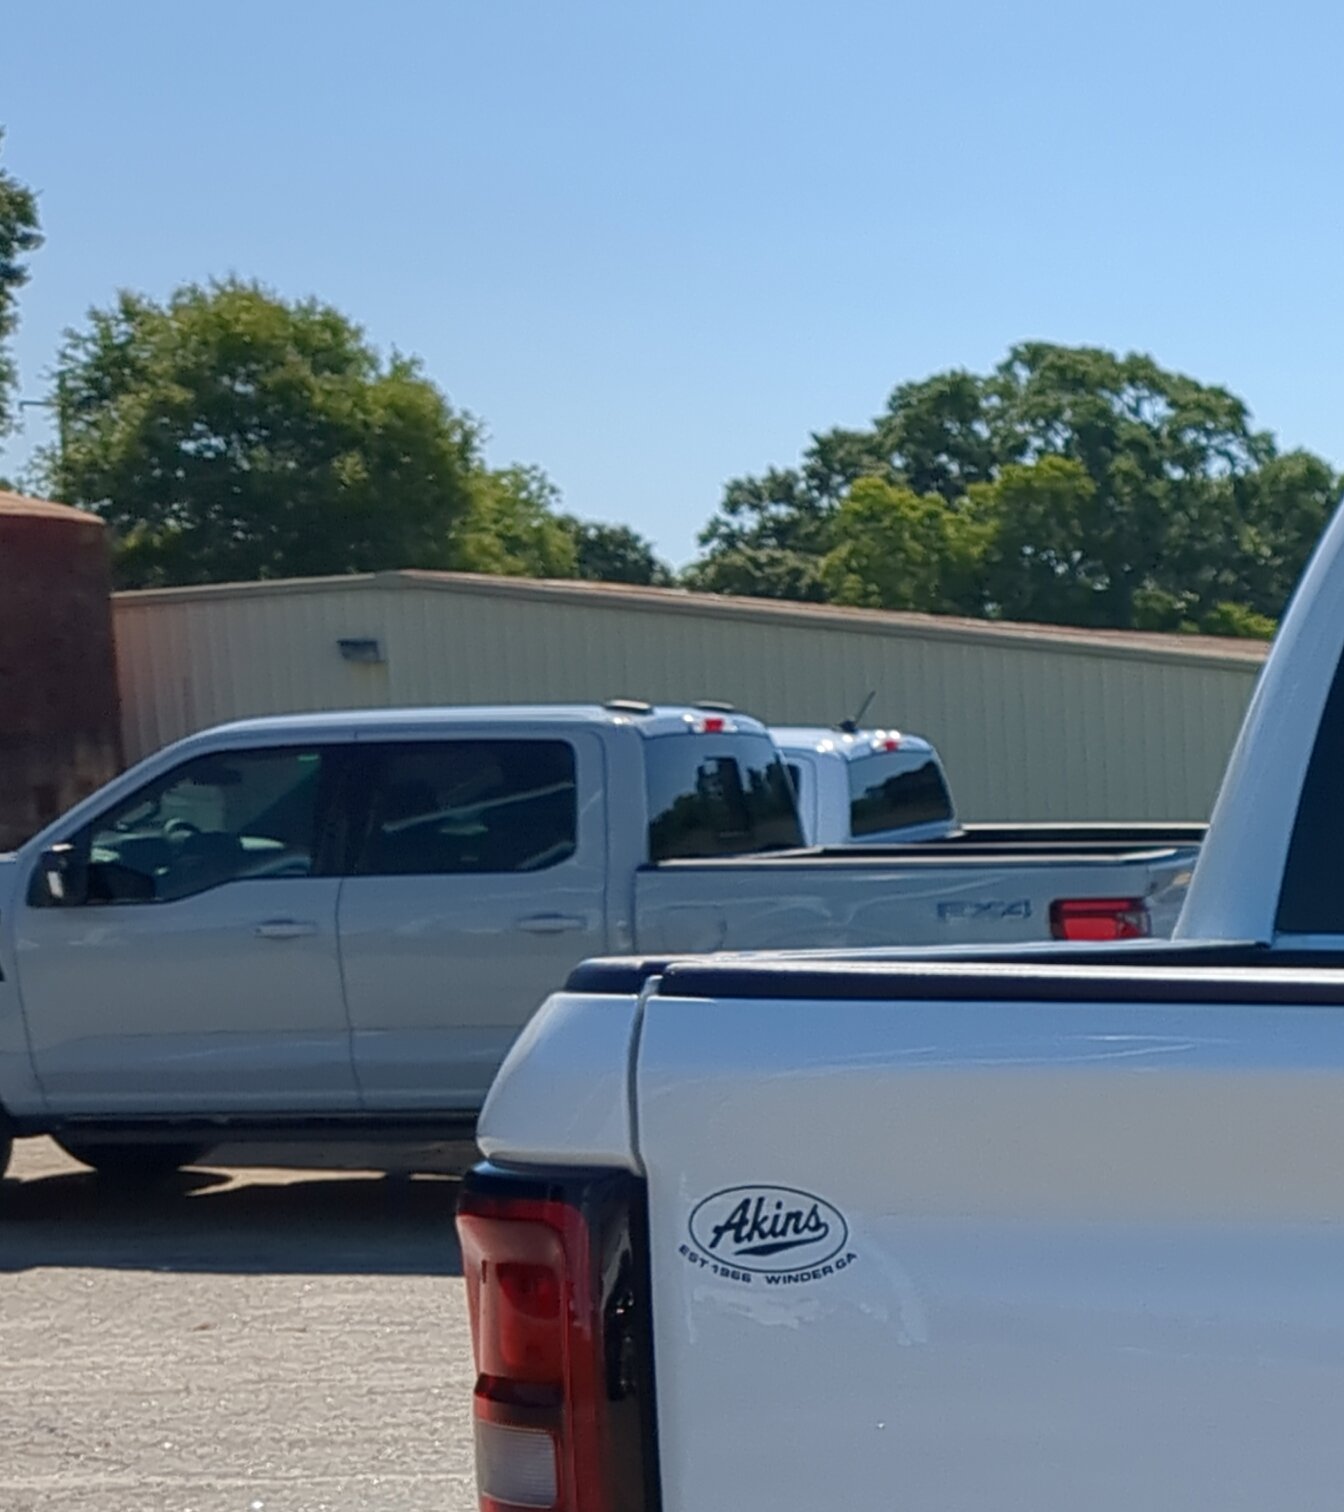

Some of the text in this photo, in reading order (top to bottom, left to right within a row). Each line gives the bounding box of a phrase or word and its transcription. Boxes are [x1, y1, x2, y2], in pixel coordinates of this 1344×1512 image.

[937, 900, 1032, 921] FX4
[708, 1196, 830, 1256] Akins
[678, 1244, 858, 1285] EST 1966 WINDER GA
